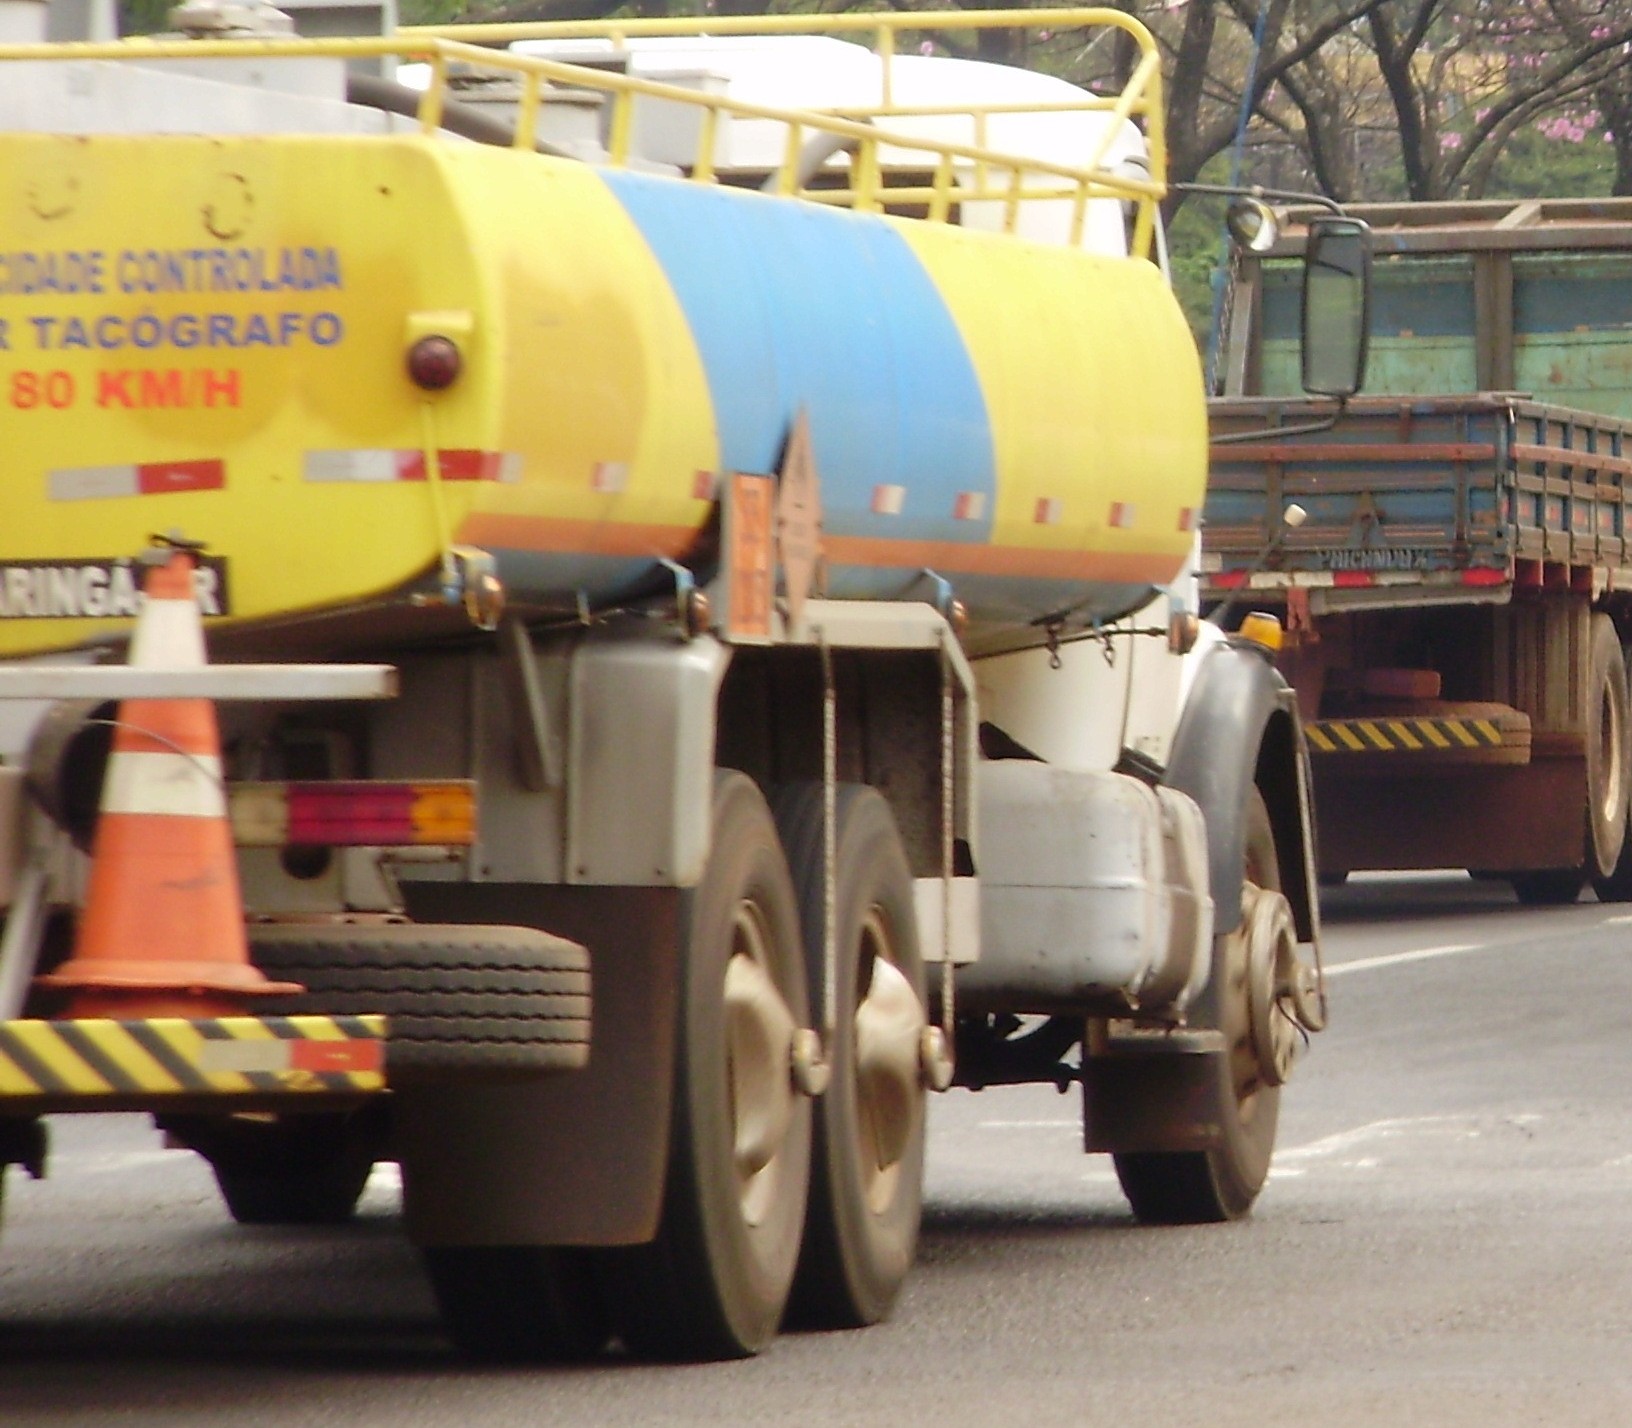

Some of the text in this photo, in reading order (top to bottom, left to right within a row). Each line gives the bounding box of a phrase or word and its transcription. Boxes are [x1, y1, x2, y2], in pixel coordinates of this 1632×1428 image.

[118, 246, 342, 294] CONTROLADA
[12, 368, 242, 410] 80 KM/H
[0, 557, 137, 617] RINGÁ
